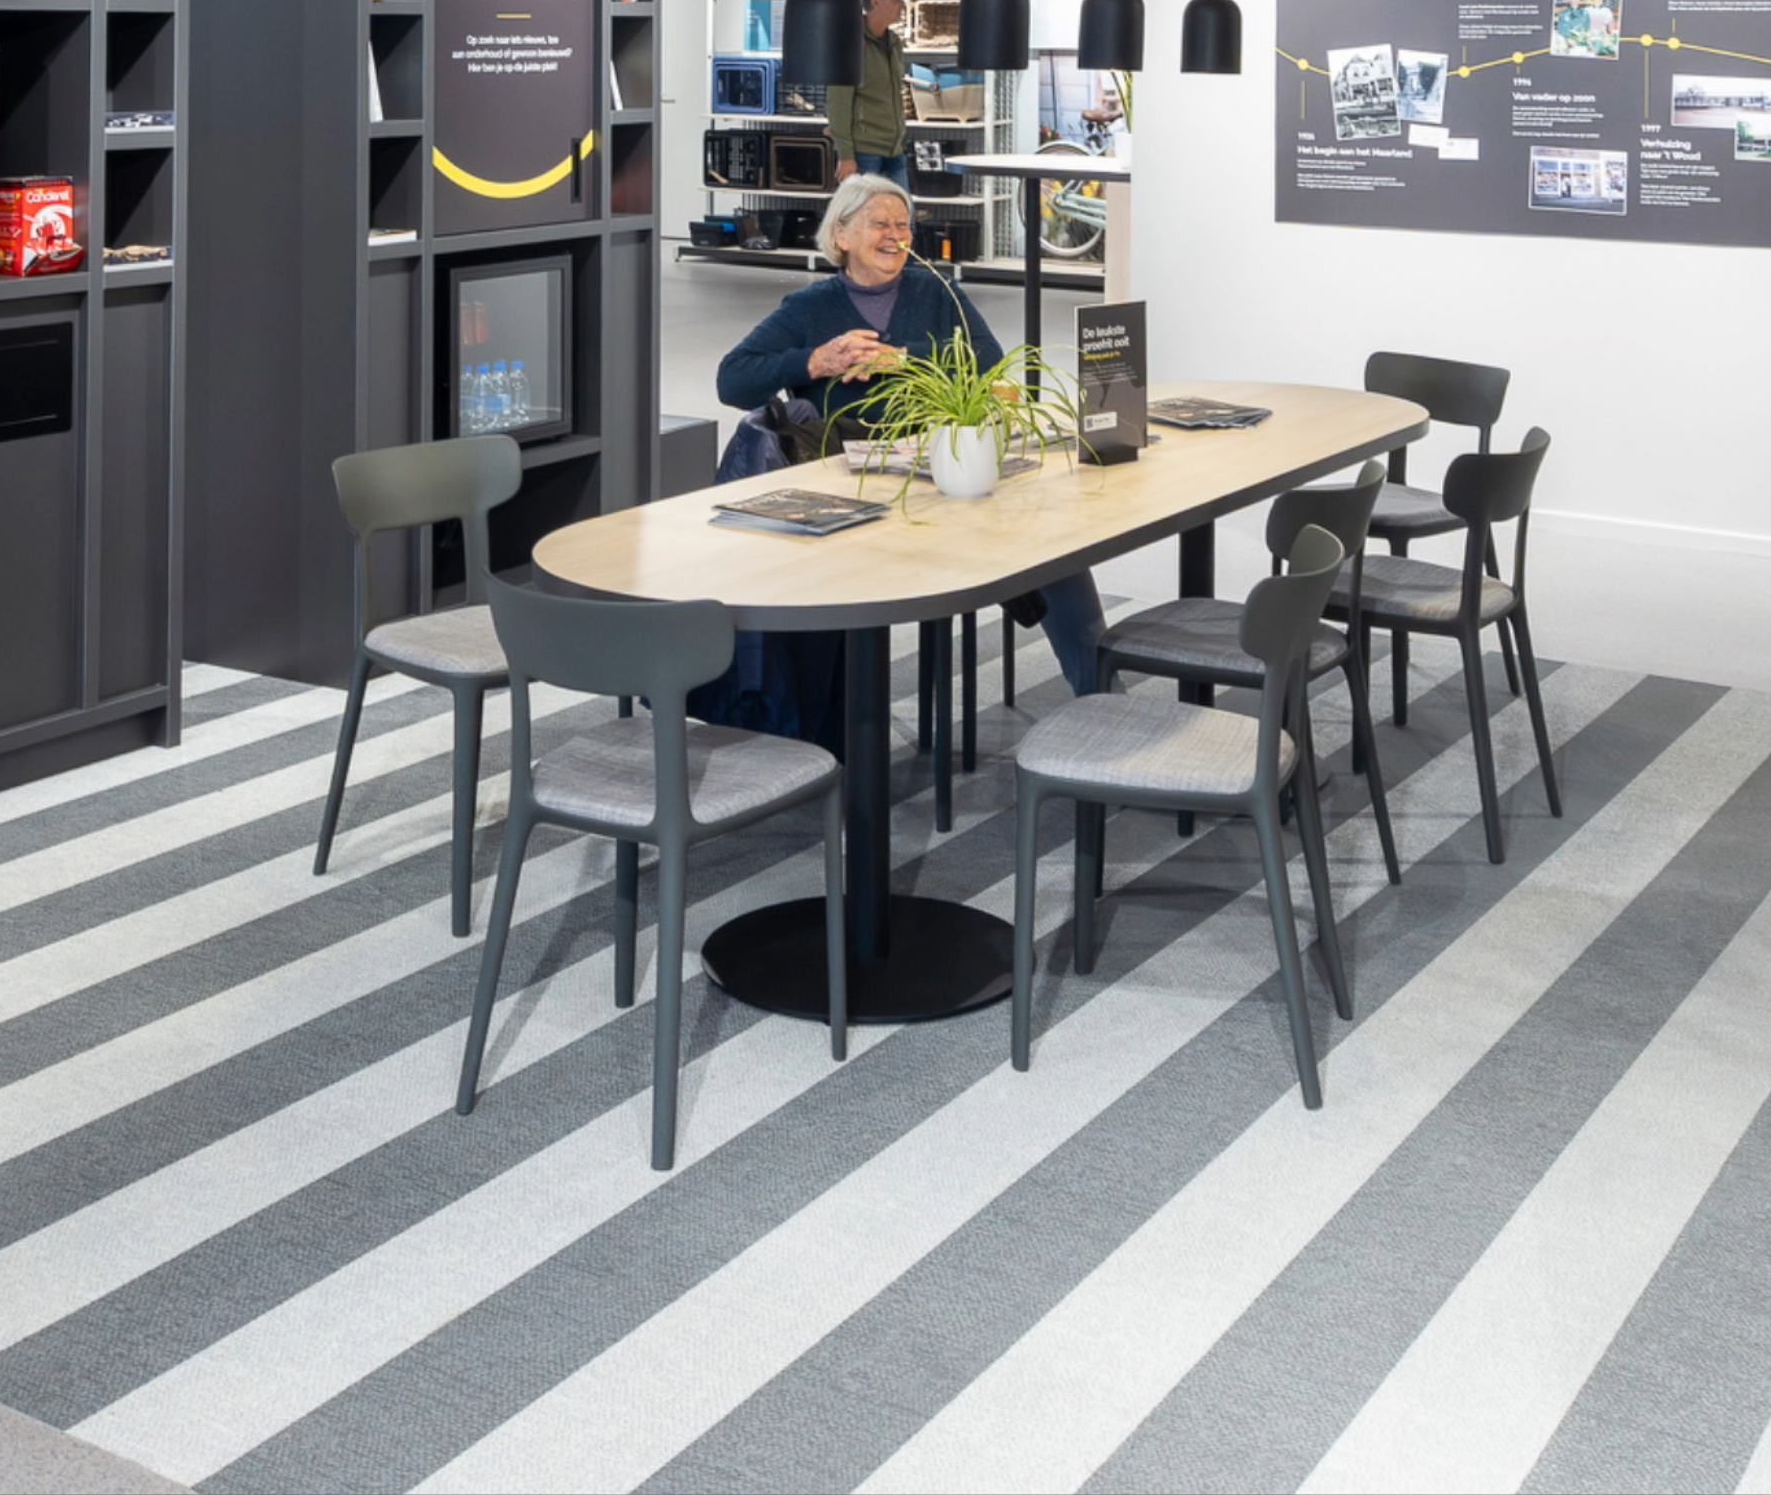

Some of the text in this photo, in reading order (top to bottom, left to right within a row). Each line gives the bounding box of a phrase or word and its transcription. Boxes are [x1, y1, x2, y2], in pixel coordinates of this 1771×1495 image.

[1512, 92, 1531, 101] Van
[1558, 95, 1571, 104] op
[1297, 146, 1312, 155] Het
[1640, 138, 1692, 152] Verhuizing
[25, 190, 70, 204] Canderel
[1083, 328, 1095, 338] De
